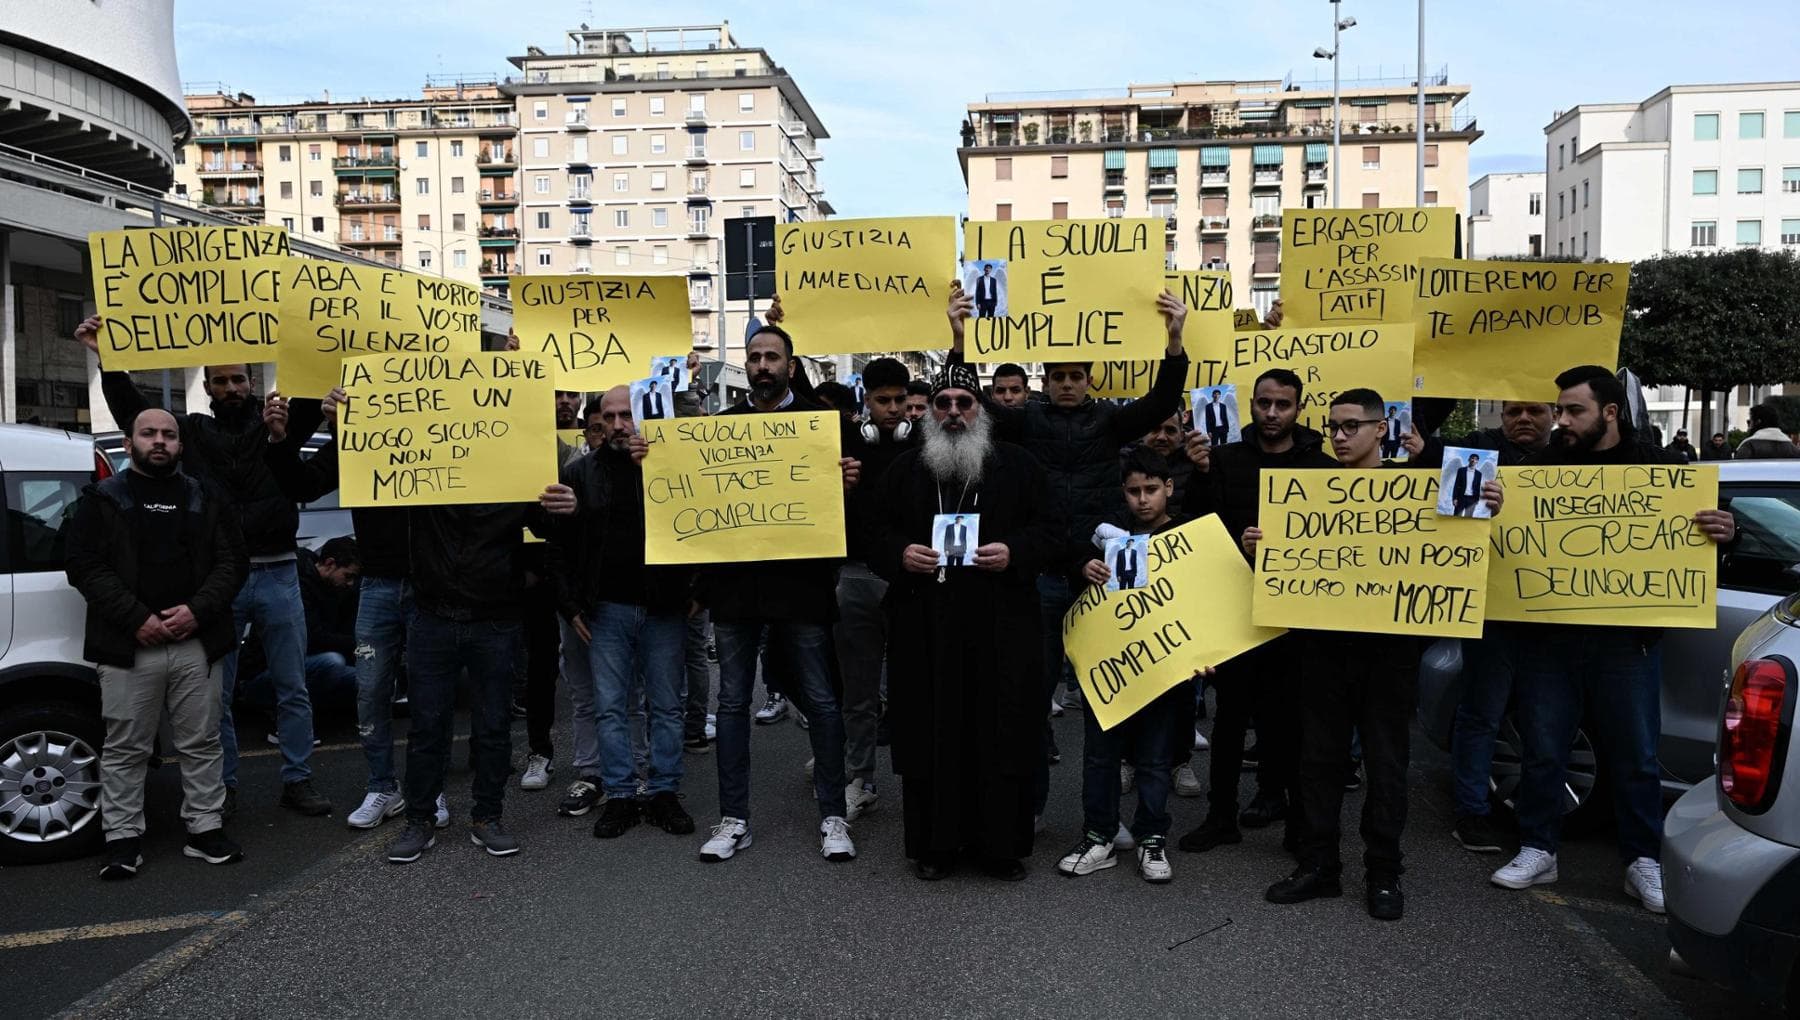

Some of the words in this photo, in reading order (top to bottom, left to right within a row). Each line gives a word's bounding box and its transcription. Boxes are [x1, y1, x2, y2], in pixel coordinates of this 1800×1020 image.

[781, 227, 912, 255] GIUSTIZIA
[1041, 221, 1148, 257] SCUOLA
[1293, 211, 1429, 247] ERGASTOLO
[101, 237, 138, 269] LA
[149, 228, 290, 267] DIRIGENZA
[1338, 243, 1379, 267] PER
[106, 271, 129, 308] È
[139, 268, 280, 305] COMPLICE
[291, 264, 361, 291] ABA
[417, 279, 479, 307] MORTO
[521, 280, 656, 307] GIUSTIZIA
[784, 270, 931, 298] IMMEDIATA
[1419, 267, 1557, 299] LOTTEREMO
[1573, 270, 1614, 293] PER
[309, 296, 360, 321] PER
[380, 301, 402, 321] IL
[573, 307, 611, 328] PER
[1330, 289, 1377, 314] ATIF
[974, 310, 1125, 355] COMPLICE
[1428, 310, 1455, 339] TE
[1469, 304, 1603, 335] ABANOUB
[316, 325, 450, 353] SILENZIO
[541, 331, 631, 373] ABA
[1235, 329, 1379, 368] ERGASTOLO
[341, 362, 373, 388] LA
[384, 355, 485, 383] SCUOLA
[493, 356, 547, 380] DEVE
[344, 387, 451, 426] ESSERE
[473, 388, 513, 408] UN
[341, 427, 414, 452] LUOGO
[427, 420, 509, 444] SICURO
[645, 426, 666, 445] LA
[677, 421, 752, 443] SCUOLA
[763, 420, 797, 437] NON
[389, 448, 433, 466] NON
[452, 445, 470, 460] DI
[373, 466, 467, 501] MORTE
[648, 474, 694, 504] CHI
[701, 469, 774, 494] TACE
[1268, 475, 1308, 505] LA
[1327, 474, 1440, 505] SCUOLA
[1517, 466, 1604, 490] SCUOLA
[1623, 466, 1697, 491] DEVE
[673, 501, 809, 536] COMPLICE
[1533, 490, 1663, 520] INSEGNARE
[1285, 507, 1438, 540] DOVREBBE
[1490, 523, 1547, 558] NON
[1559, 515, 1707, 557] CREARE
[1262, 545, 1367, 573] ESSERE
[1379, 546, 1410, 567] UN
[1420, 542, 1484, 568] POSTO
[1265, 577, 1346, 597] SICURO
[1356, 582, 1393, 598] NON
[1394, 579, 1479, 625] MORTE
[1515, 566, 1706, 604] DELINQUENTI
[1114, 577, 1175, 631] SONO
[1089, 620, 1192, 705] COMPLICI
